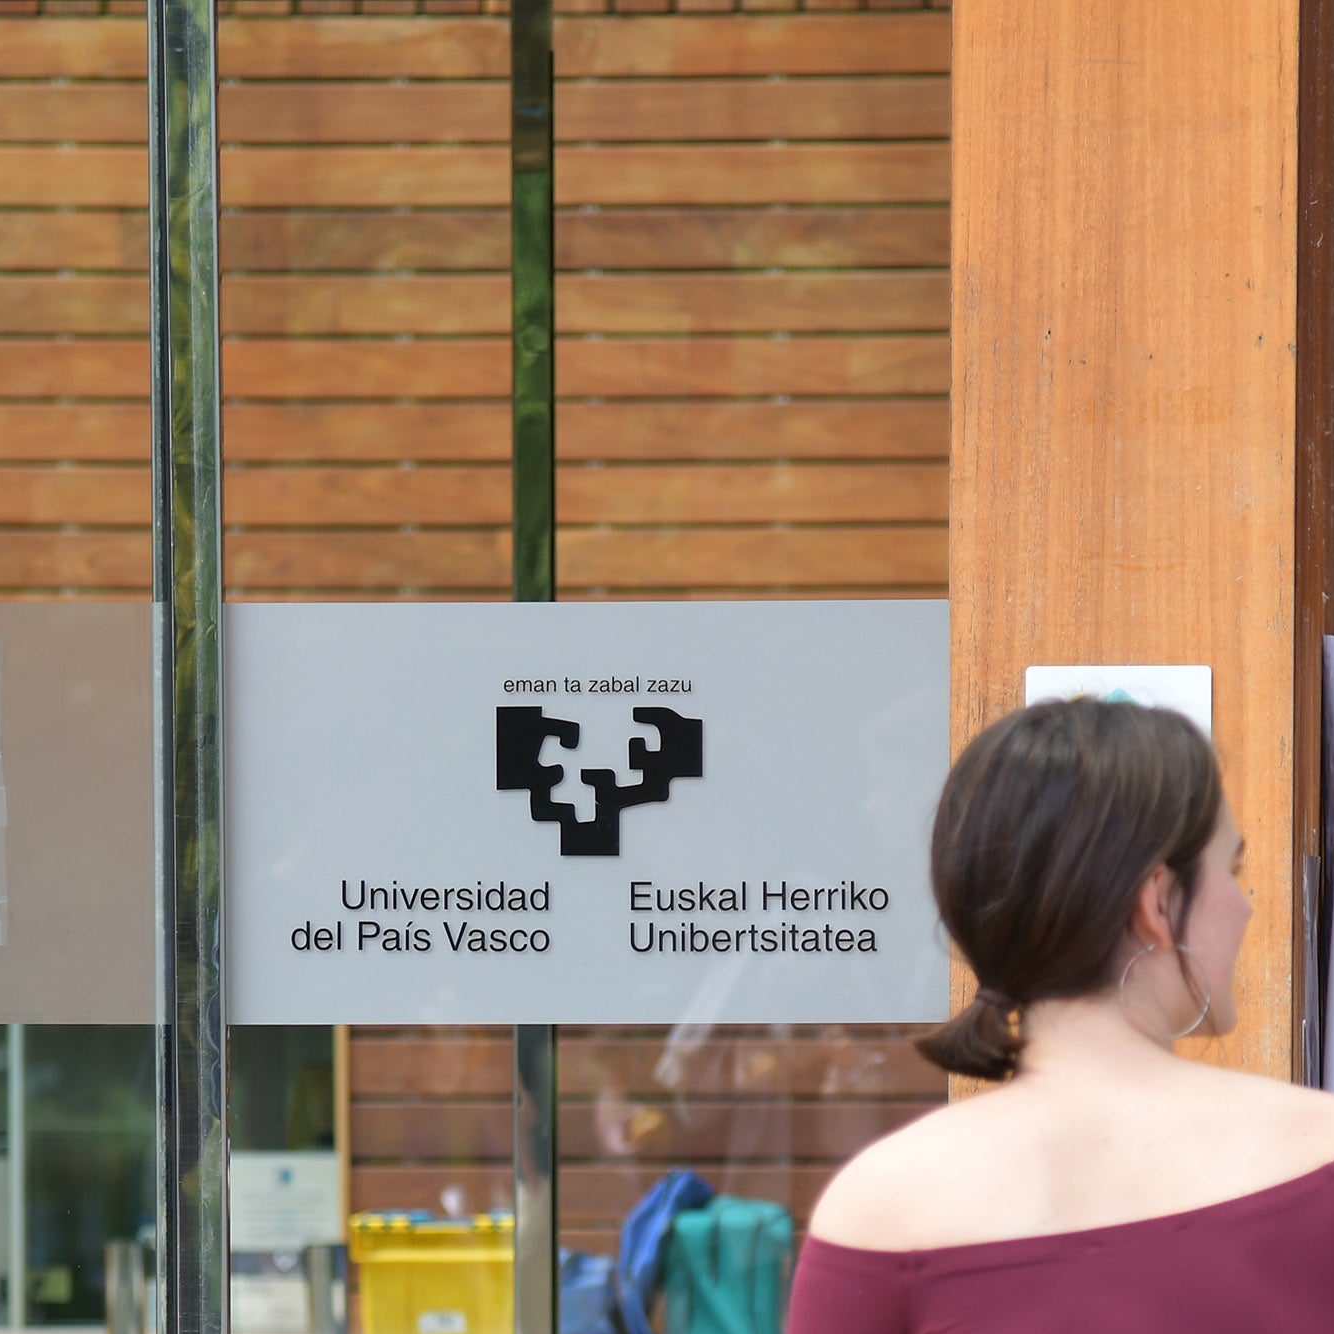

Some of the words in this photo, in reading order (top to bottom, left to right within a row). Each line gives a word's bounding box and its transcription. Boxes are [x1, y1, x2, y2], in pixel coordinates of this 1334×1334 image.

[503, 678, 557, 694] eman
[564, 676, 582, 694] ta
[588, 675, 640, 694] zabal
[646, 679, 692, 694] zazu
[341, 880, 550, 912] Universidad
[629, 881, 747, 912] Euskal
[762, 881, 889, 912] Herriko
[290, 920, 343, 952] del
[357, 921, 432, 953] País
[442, 921, 551, 953] Vasco
[629, 922, 878, 953] Unibertsitatea
